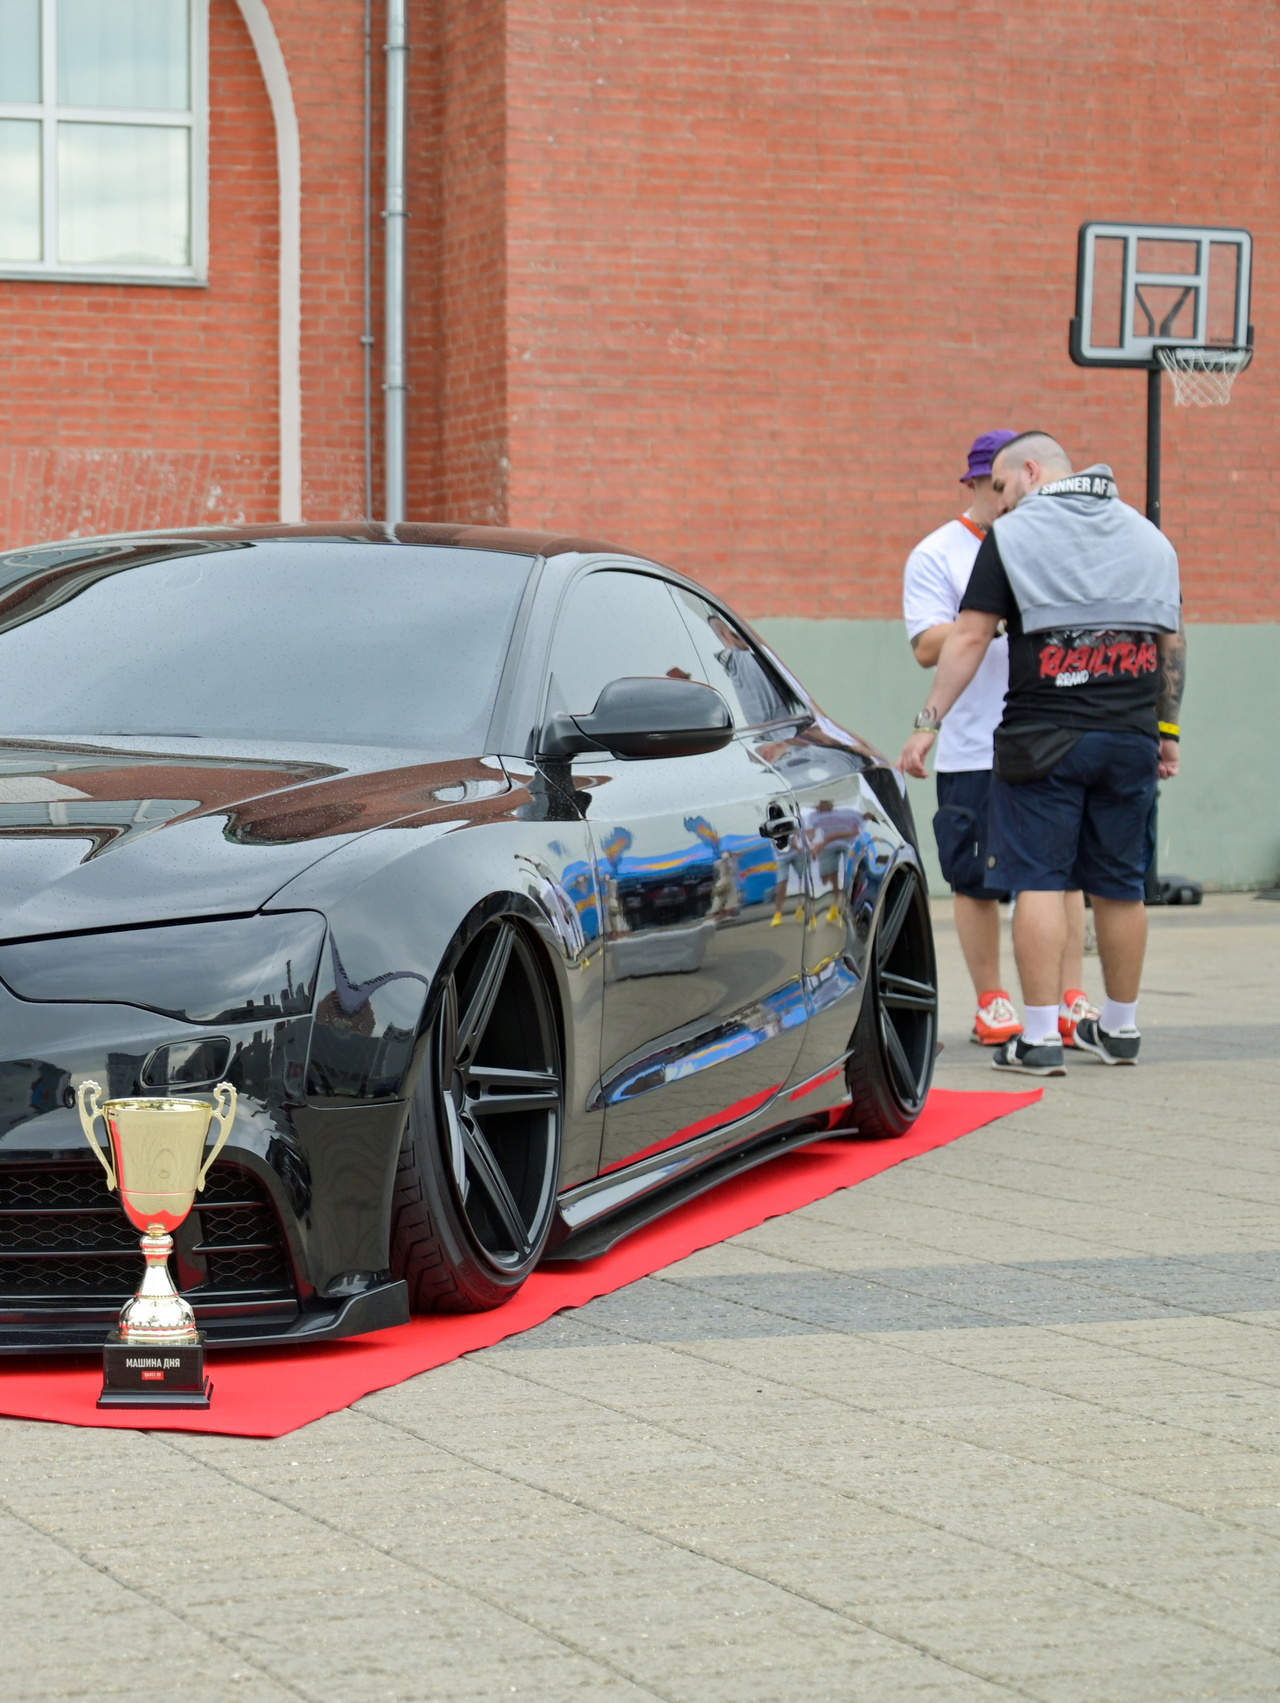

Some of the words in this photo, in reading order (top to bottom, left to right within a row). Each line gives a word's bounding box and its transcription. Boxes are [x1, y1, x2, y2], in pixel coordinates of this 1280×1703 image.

[1055, 669, 1089, 687] BRAND
[126, 1358, 162, 1368] МАШИНА
[163, 1358, 180, 1369] ДНЯ
